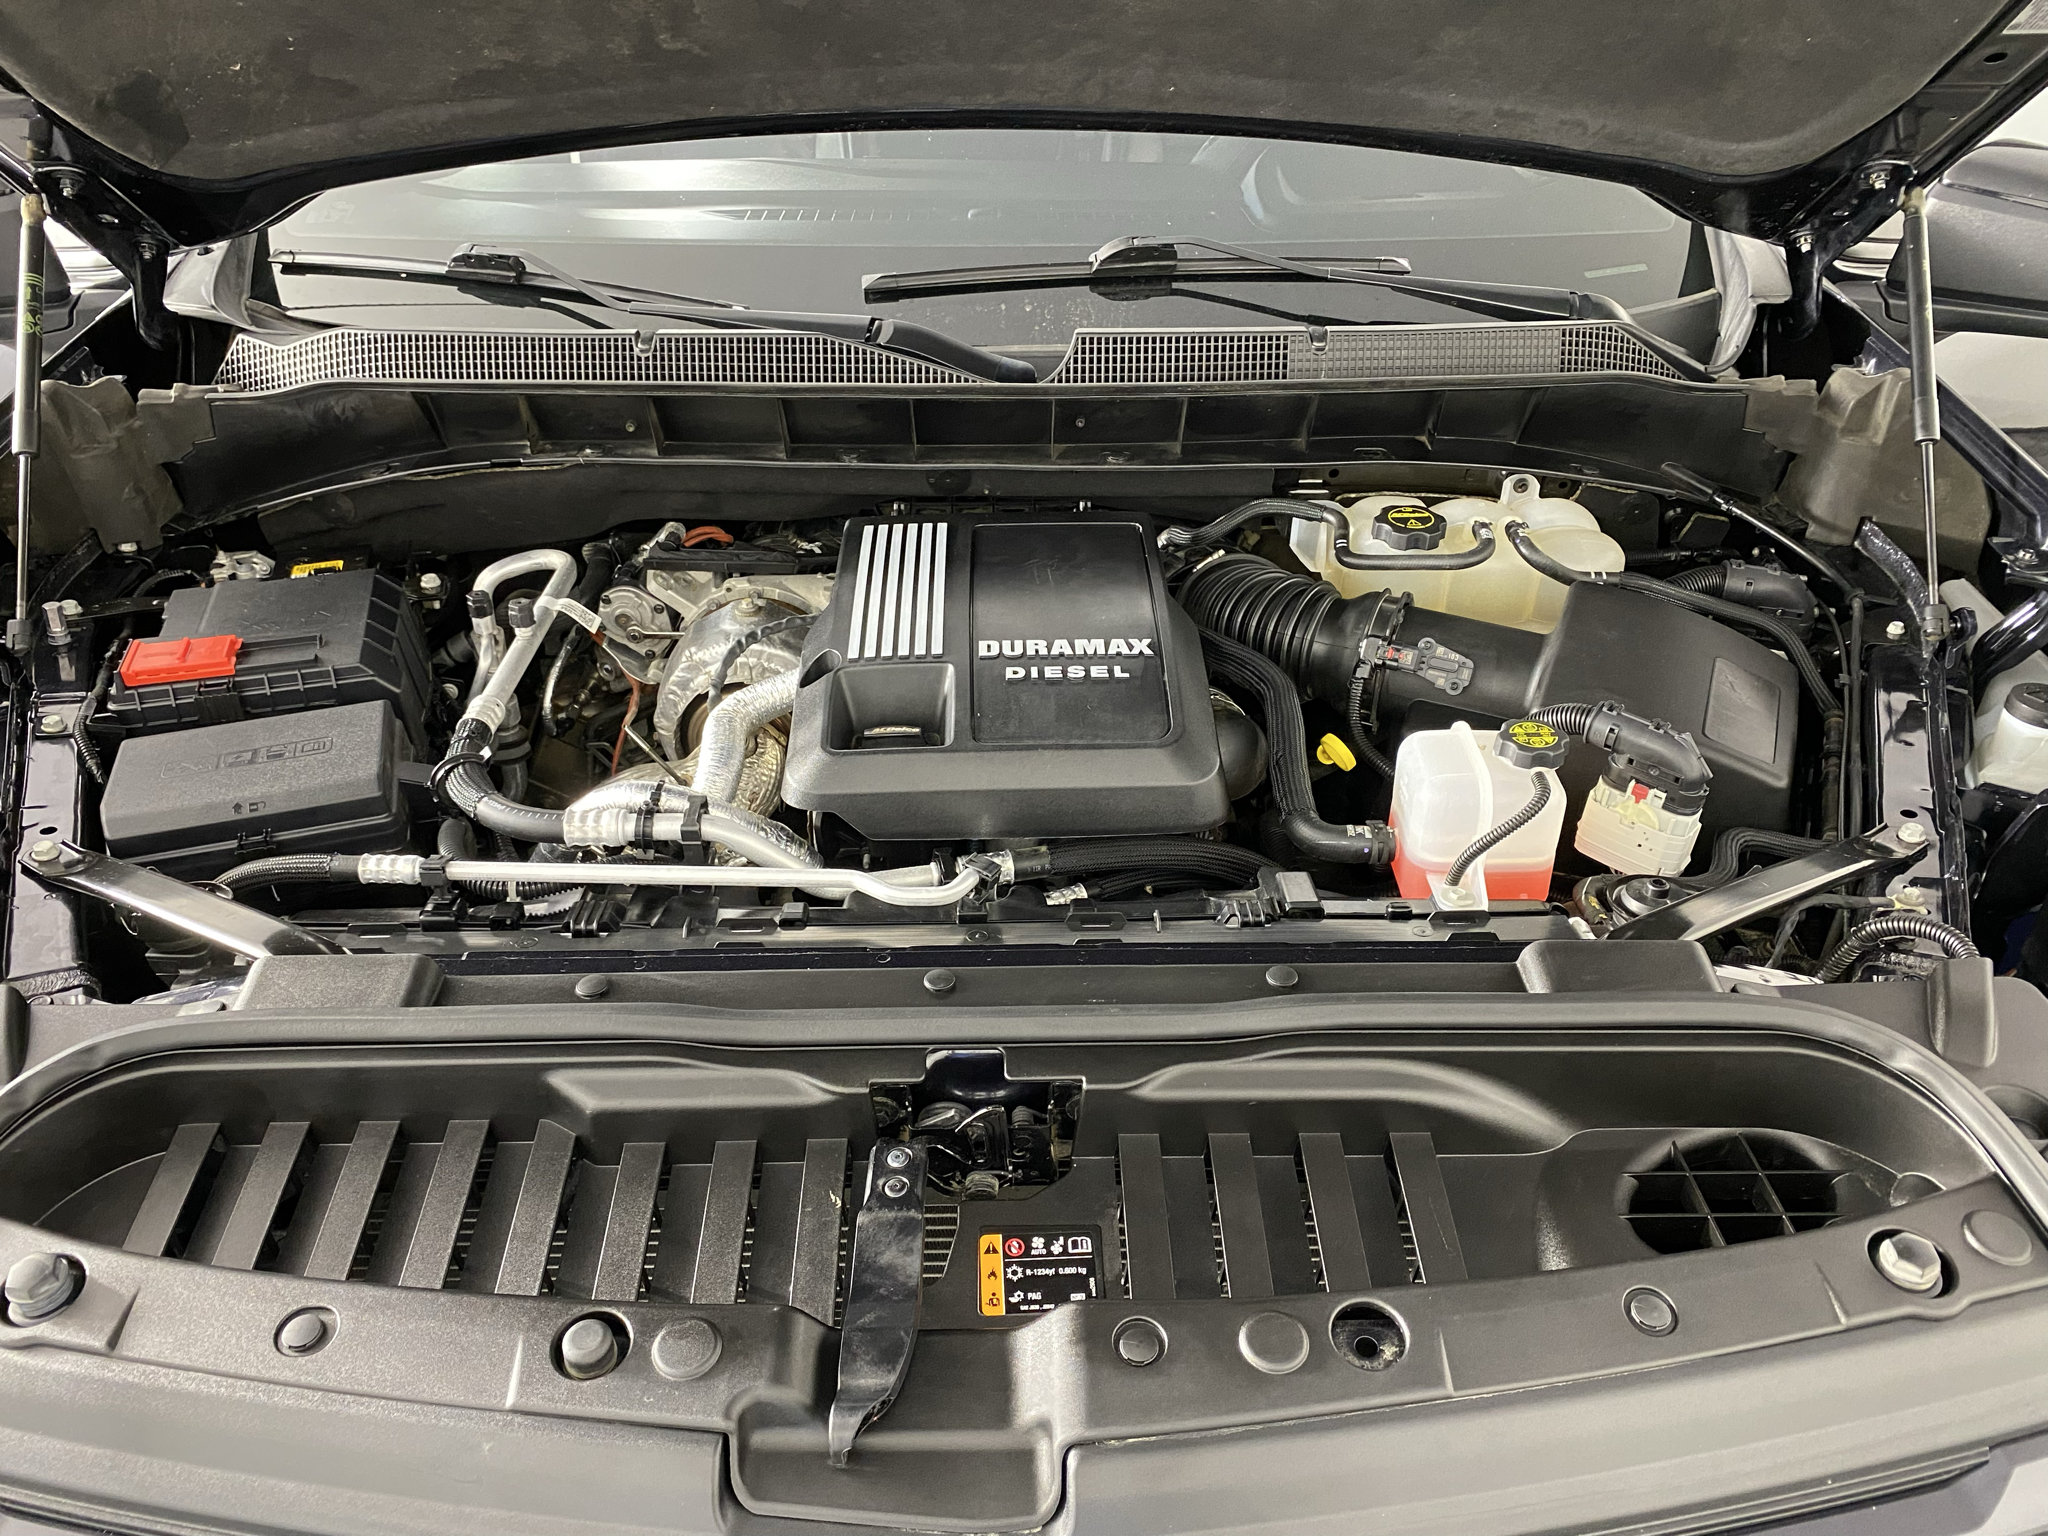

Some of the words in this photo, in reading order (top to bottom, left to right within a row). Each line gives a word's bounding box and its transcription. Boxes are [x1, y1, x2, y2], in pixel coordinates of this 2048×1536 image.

[978, 638, 1154, 658] DURAMAX
[1005, 665, 1130, 681] DIESEL
[1026, 1267, 1055, 1276] R-1234yf
[1078, 1266, 1087, 1275] kg
[1027, 1292, 1042, 1301] PAG
